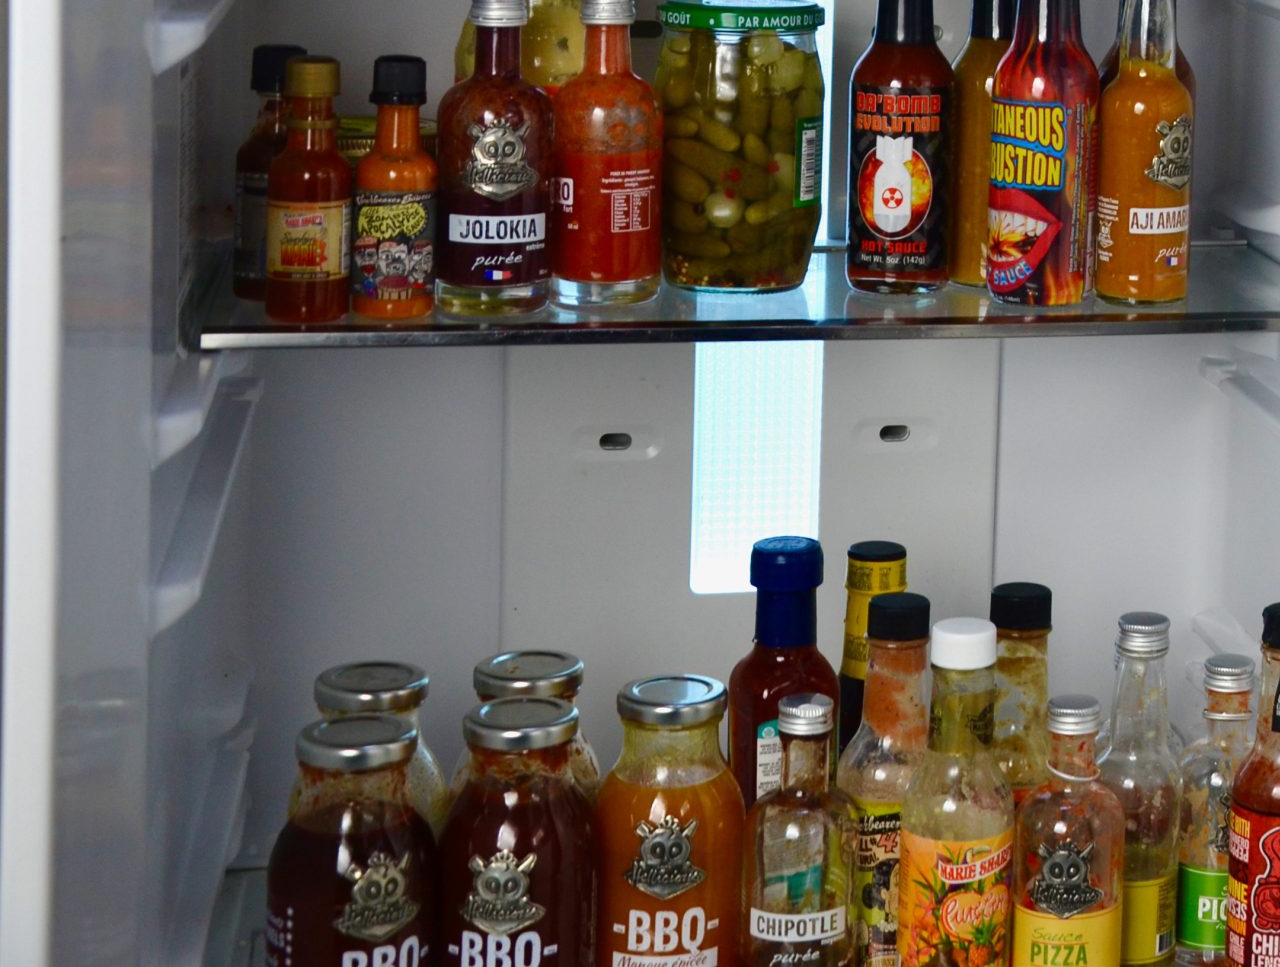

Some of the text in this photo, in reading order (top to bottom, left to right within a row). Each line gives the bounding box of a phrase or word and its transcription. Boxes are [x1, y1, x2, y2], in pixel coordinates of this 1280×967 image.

[668, 11, 691, 25] GOÛT
[738, 16, 760, 28] PAR
[763, 15, 801, 27] AMOUR
[857, 91, 941, 115] DA'BOMB
[856, 112, 940, 133] EVOLUTION
[460, 218, 537, 240] JOLOKIA
[1131, 212, 1153, 229] AJI
[861, 239, 927, 254] HOT SAUCE
[471, 251, 523, 271] purée
[861, 254, 871, 262] Net
[873, 255, 883, 263] Wt.
[903, 255, 926, 264] (142g)
[993, 260, 1033, 286] SAUCE
[939, 864, 977, 881] MARIE
[627, 906, 706, 953] BBQ
[757, 913, 838, 937] CHIPOTLE
[1032, 927, 1083, 941] Sauce
[769, 948, 820, 967] purée
[1030, 943, 1088, 966] PIZZA
